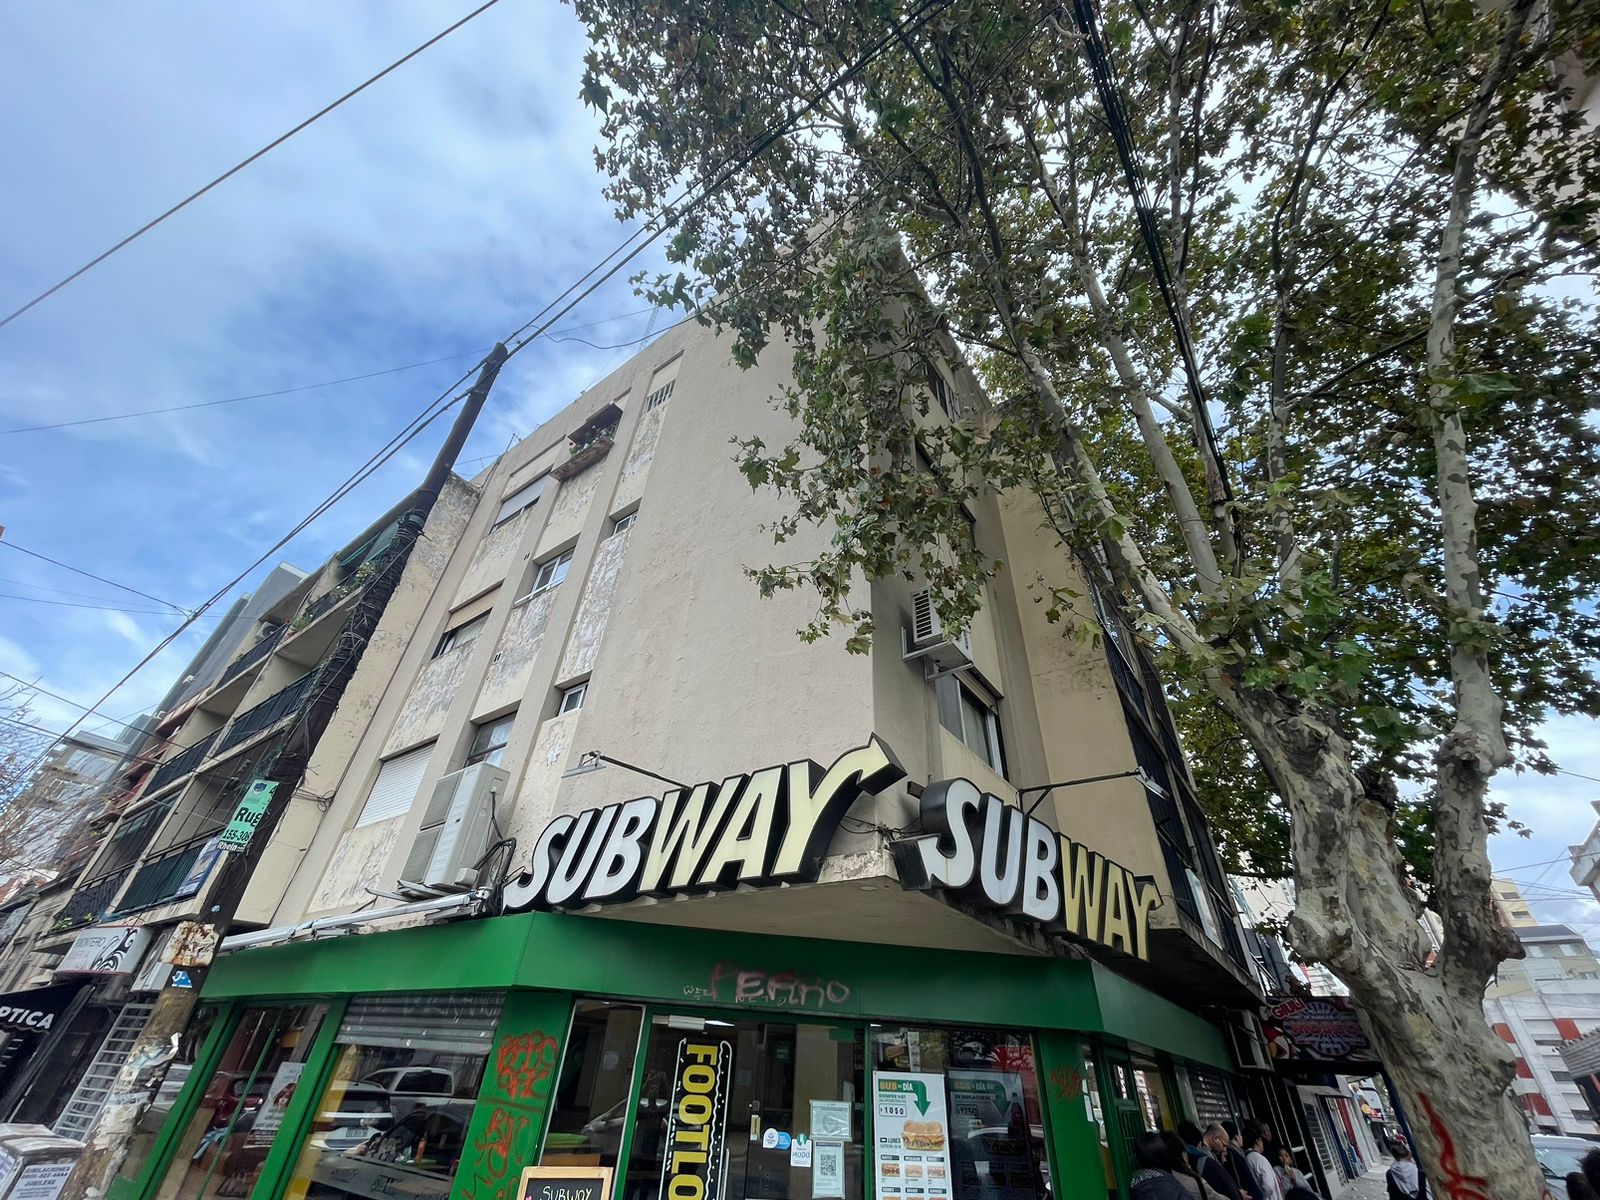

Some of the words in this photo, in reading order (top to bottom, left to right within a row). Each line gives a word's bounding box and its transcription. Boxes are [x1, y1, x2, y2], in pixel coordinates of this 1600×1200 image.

[501, 733, 900, 913] SUBWAY
[908, 777, 1164, 962] SUBWAY
[668, 1044, 718, 1200] FOOTLO
